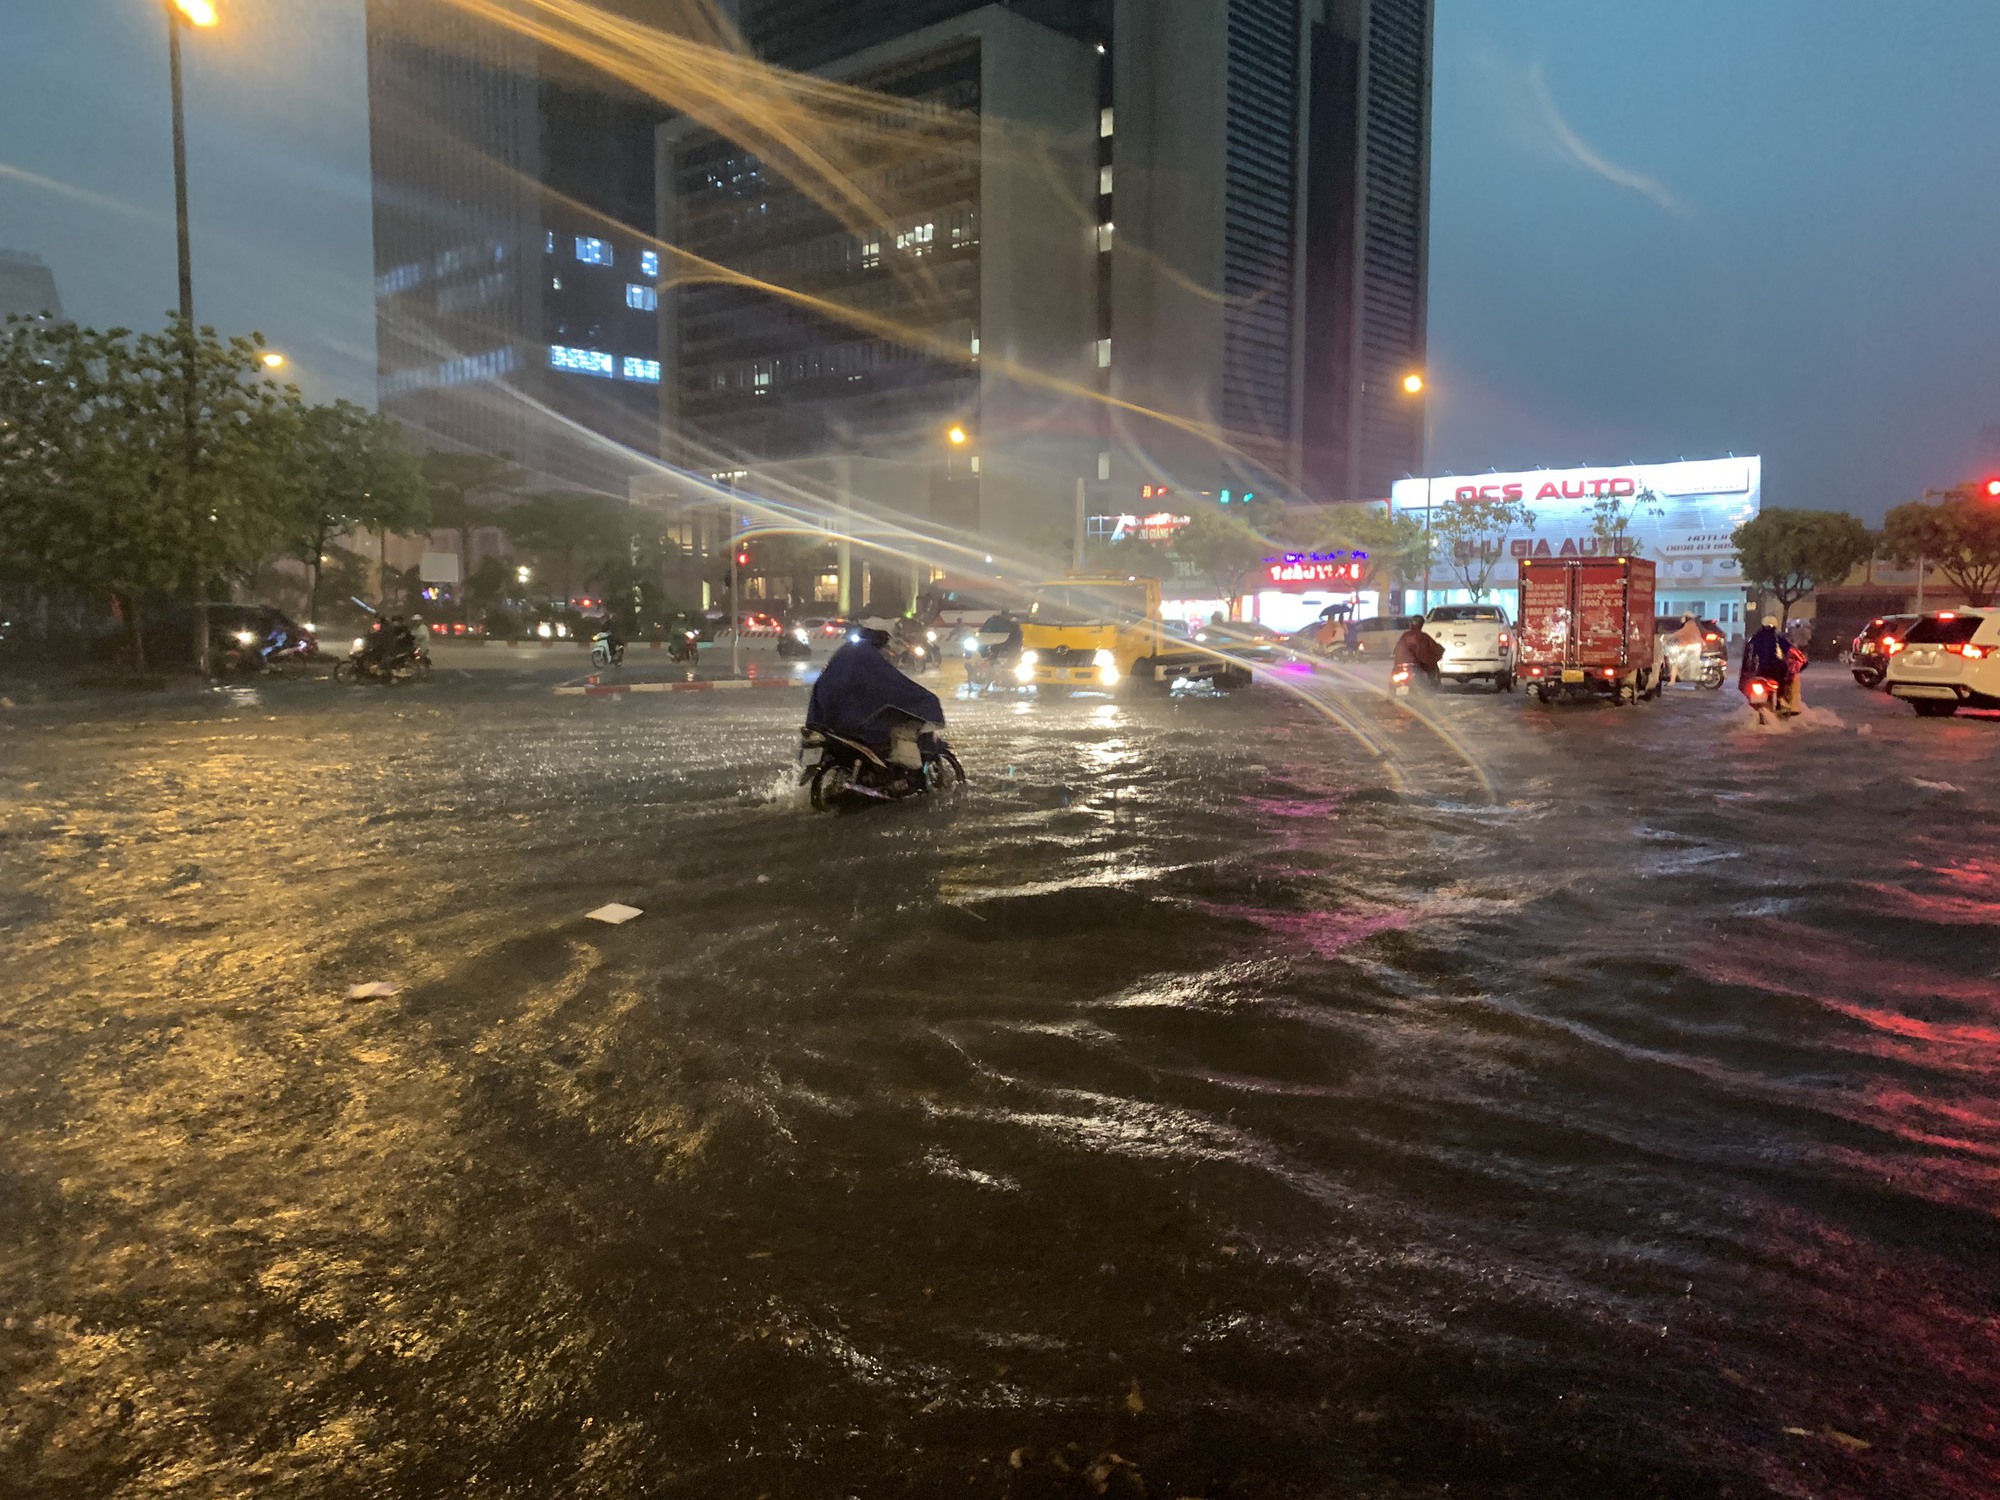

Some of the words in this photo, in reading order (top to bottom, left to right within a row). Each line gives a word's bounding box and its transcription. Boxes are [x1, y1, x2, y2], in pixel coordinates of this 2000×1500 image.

[1535, 477, 1635, 501] AUTO
[1511, 537, 1552, 557] GIA
[1559, 536, 1636, 557] AUTO
